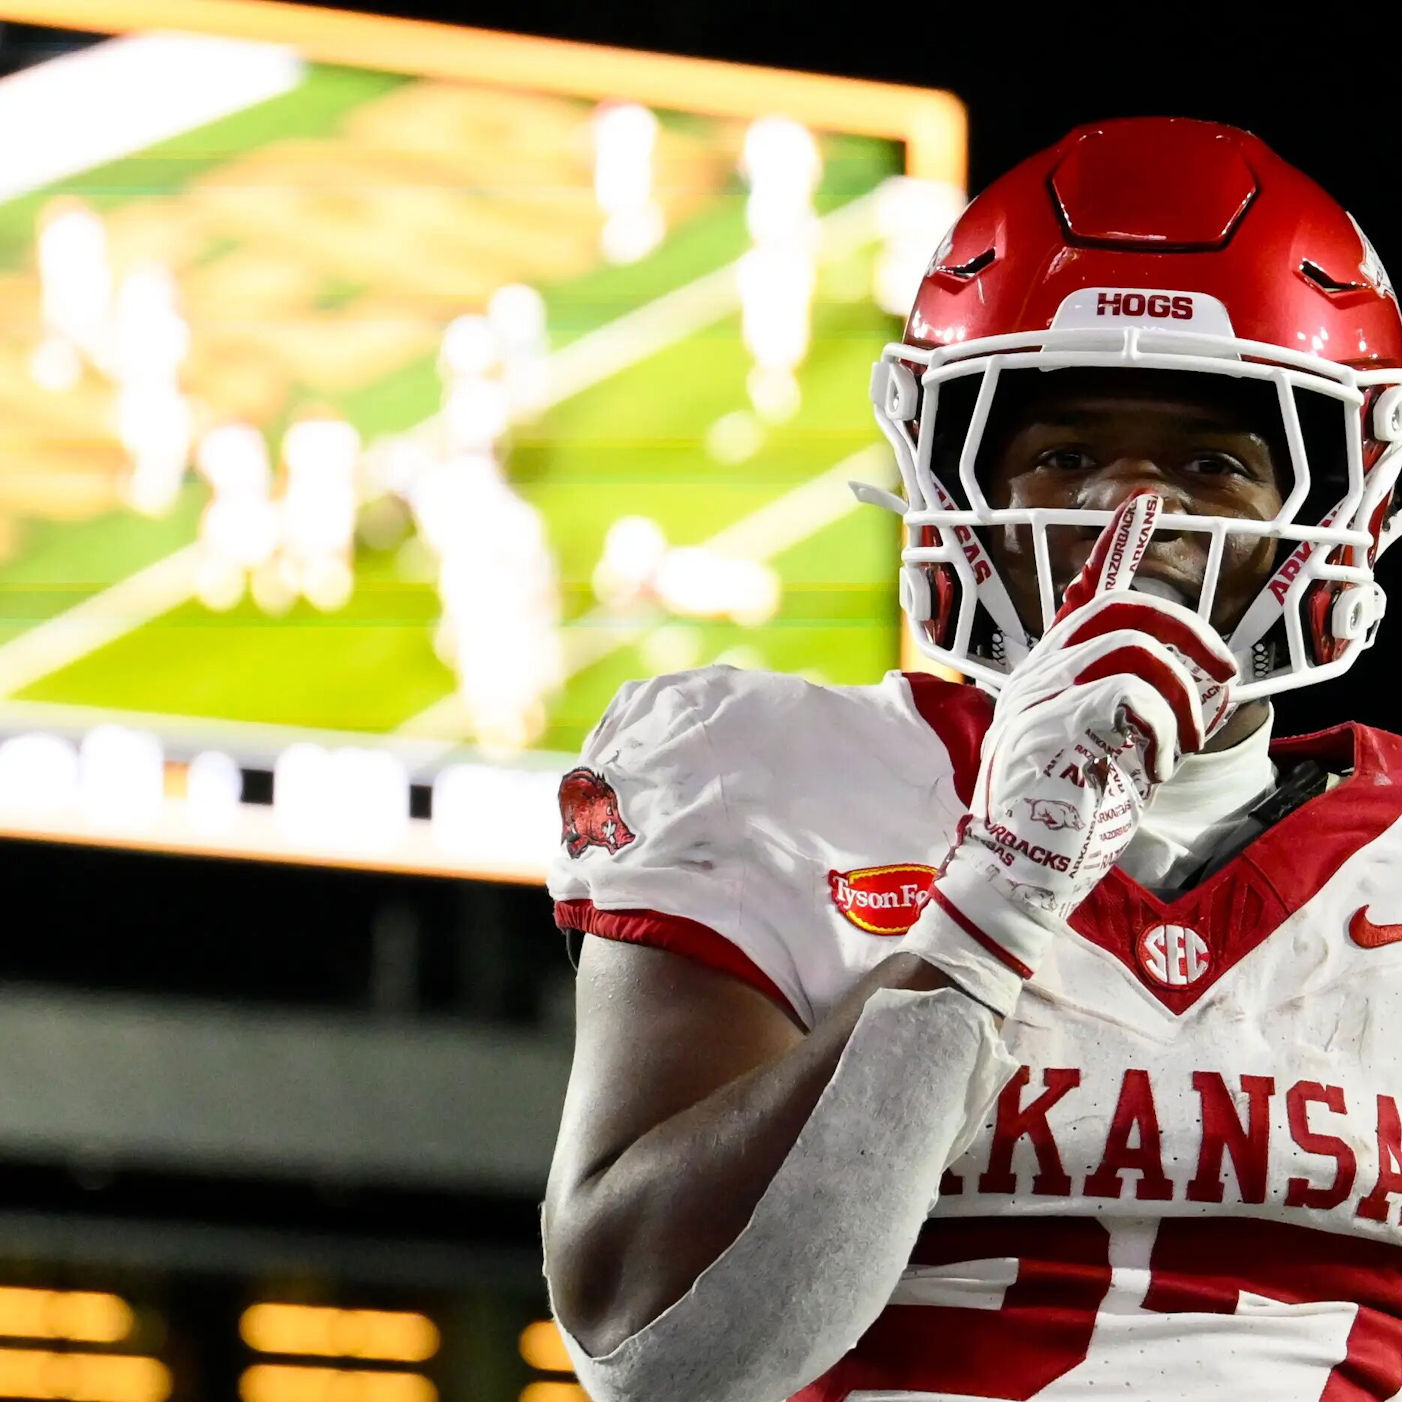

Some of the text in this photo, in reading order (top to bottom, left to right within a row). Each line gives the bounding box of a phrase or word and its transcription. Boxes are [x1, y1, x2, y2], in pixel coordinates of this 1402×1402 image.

[1096, 293, 1193, 320] HOGS
[833, 876, 900, 910] Tyson
[1143, 924, 1210, 986] SEC
